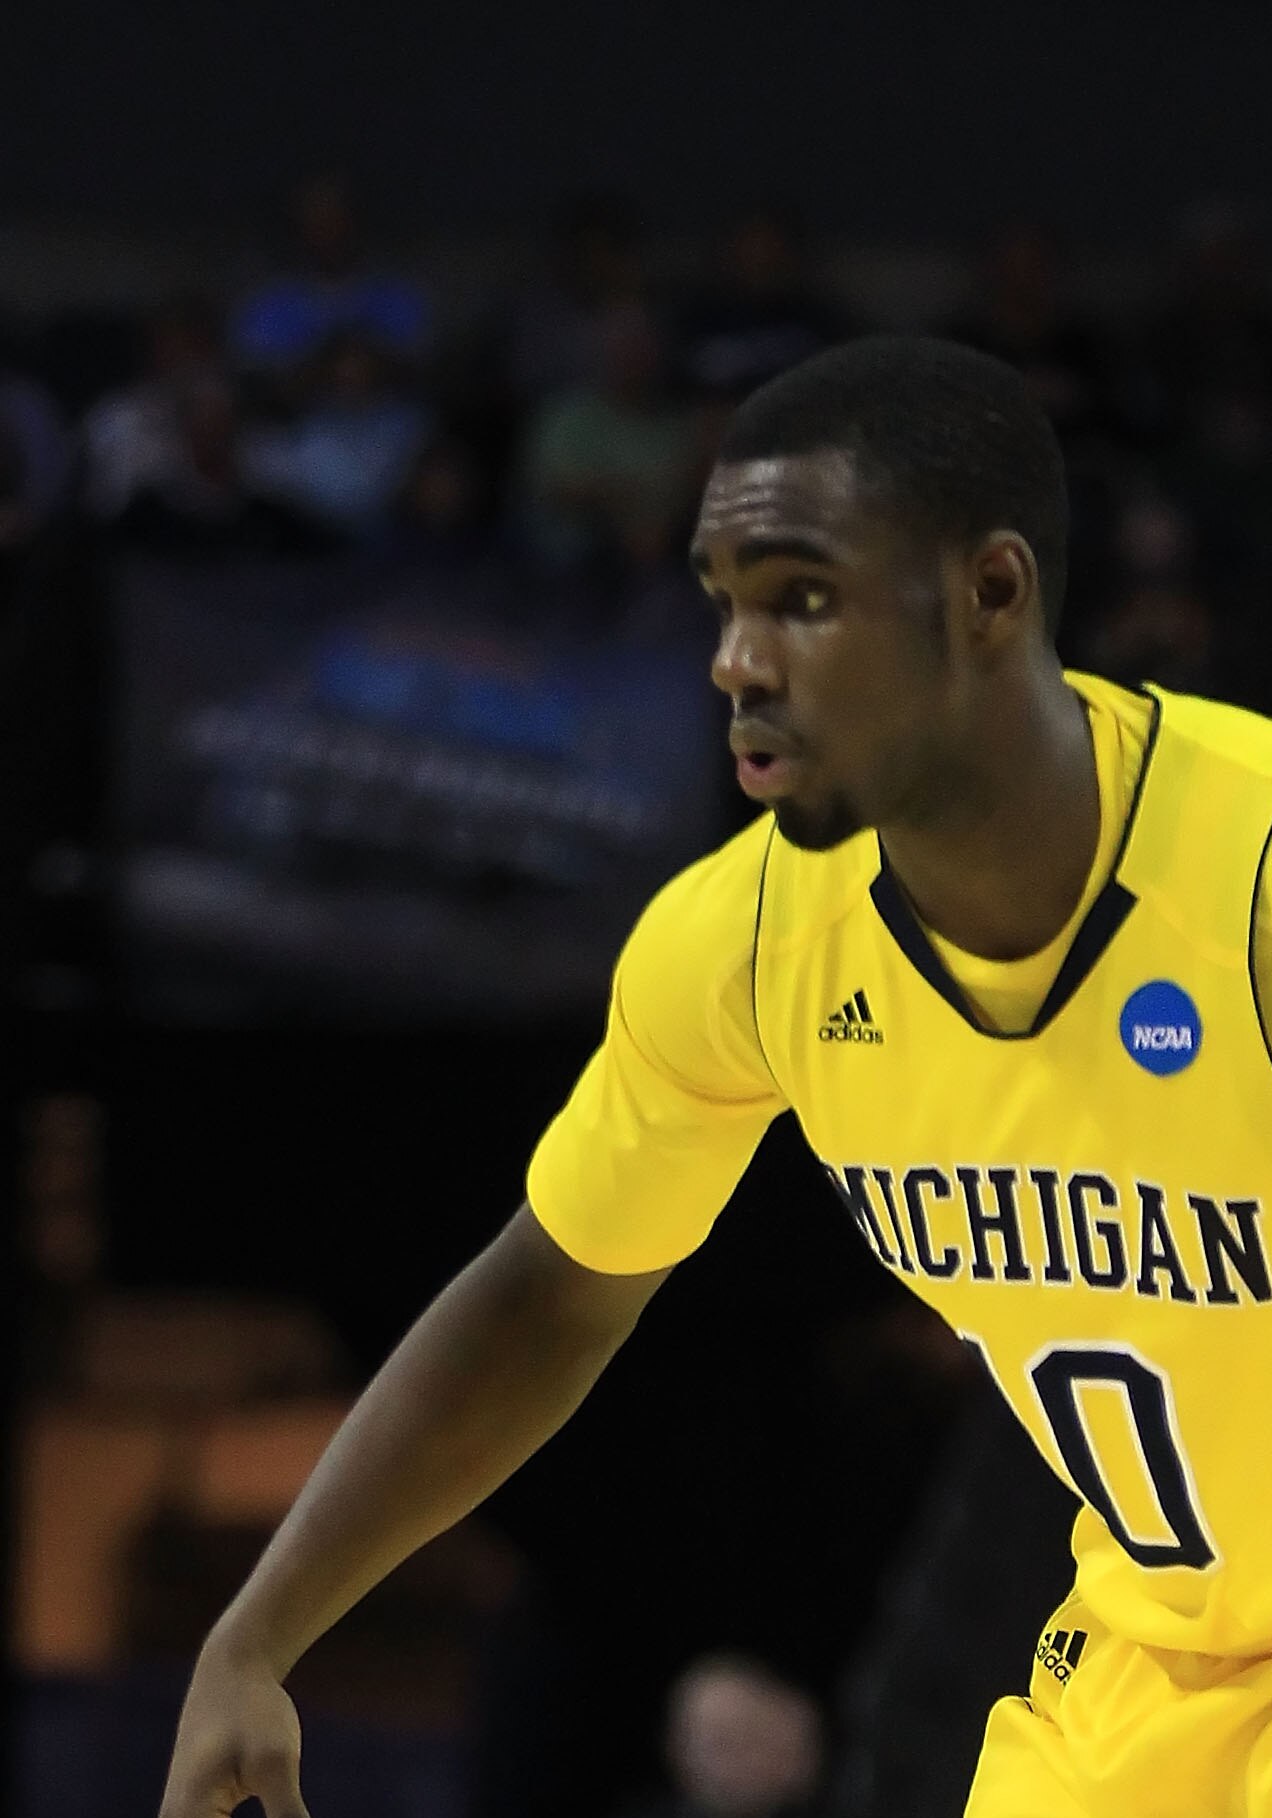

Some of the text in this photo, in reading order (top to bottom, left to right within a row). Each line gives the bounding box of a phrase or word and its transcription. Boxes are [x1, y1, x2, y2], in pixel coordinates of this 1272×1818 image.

[819, 1020, 884, 1045] adidas
[1132, 1024, 1193, 1052] NCAA
[957, 1333, 1219, 1571] 0
